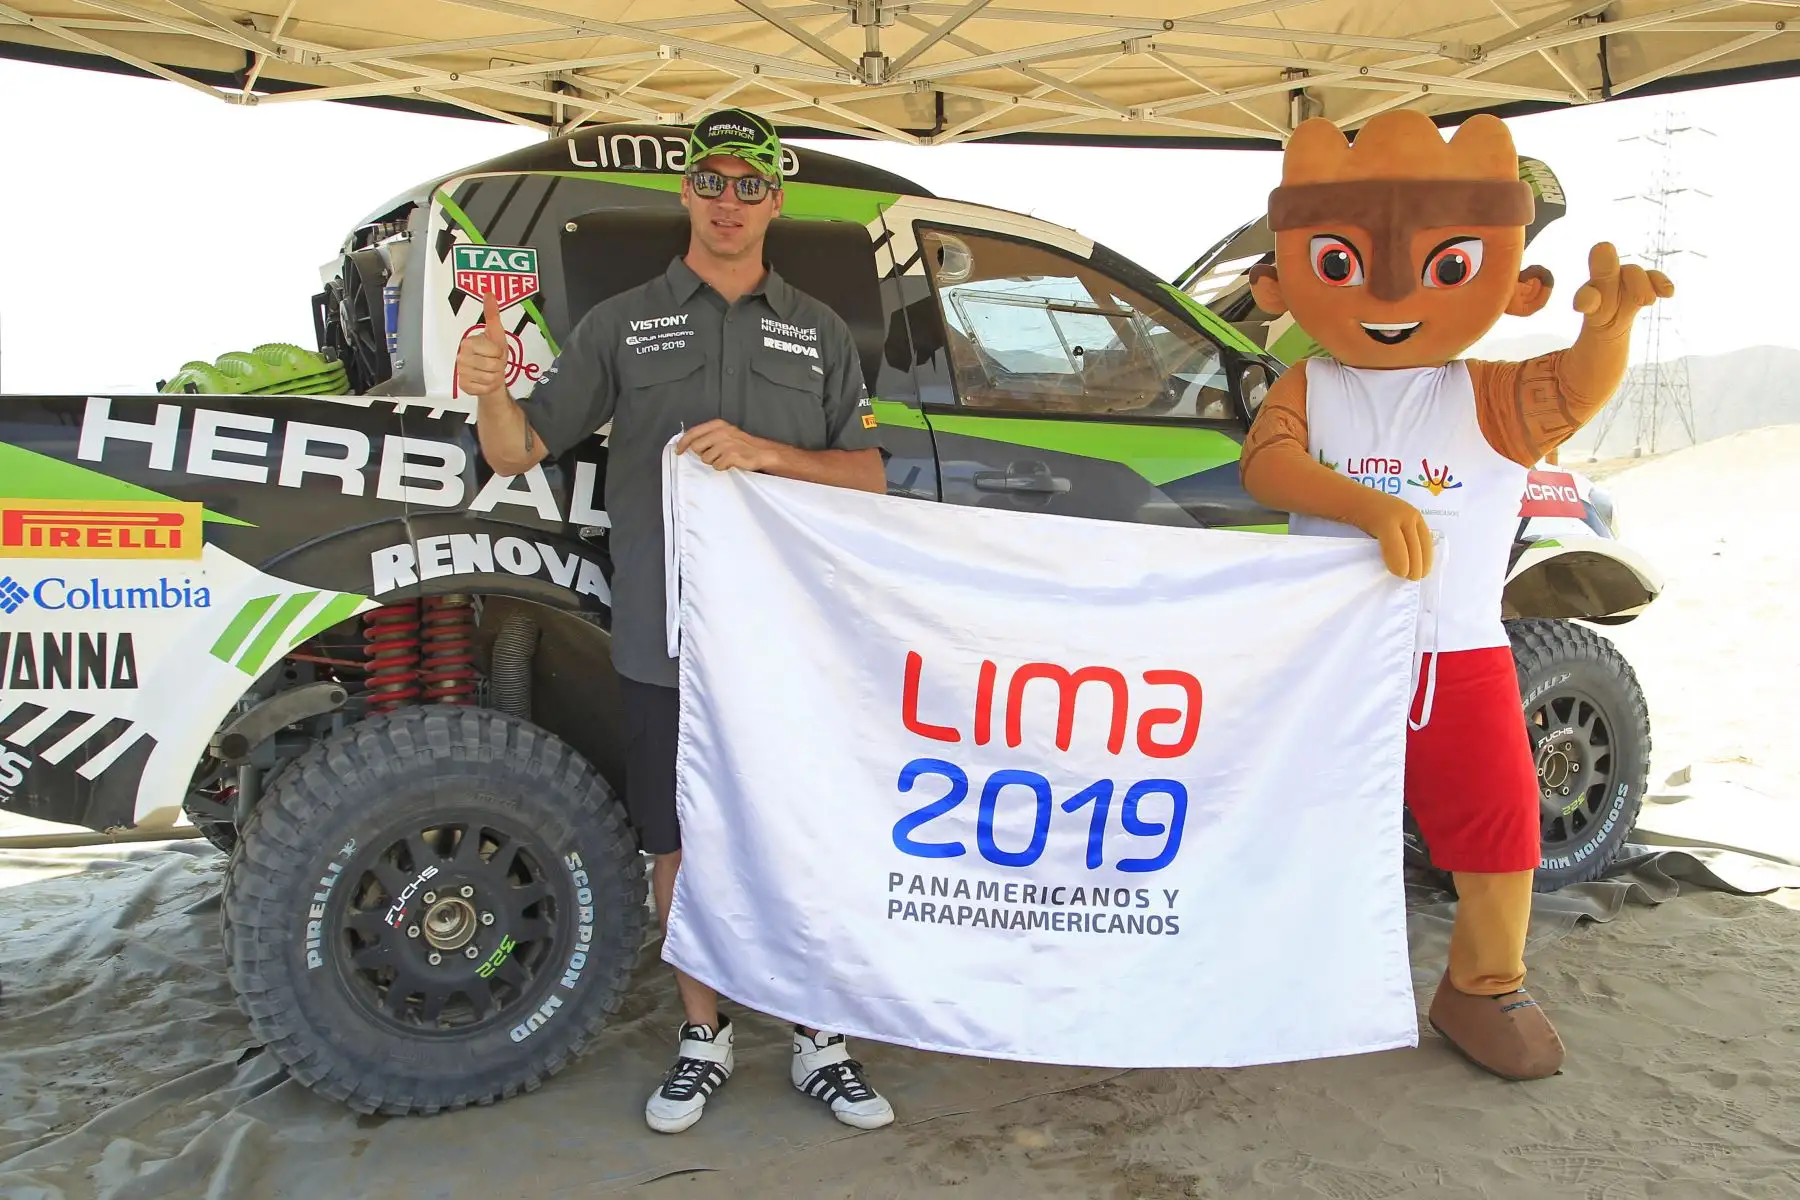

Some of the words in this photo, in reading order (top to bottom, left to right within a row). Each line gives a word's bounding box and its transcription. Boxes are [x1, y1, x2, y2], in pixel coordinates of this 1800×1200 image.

[708, 130, 754, 141] NUTRITION
[709, 124, 755, 135] HERBALIFE
[461, 249, 530, 271] TAG
[461, 274, 535, 305] HEUER
[630, 314, 688, 331] VISTONY
[761, 317, 817, 335] HERBALIFE
[761, 324, 817, 341] NUTRITION
[662, 340, 685, 350] 2019
[764, 336, 819, 359] RENOVA
[1350, 476, 1401, 494] 019
[3, 509, 184, 548] PIRELLI
[371, 533, 612, 605] RENOVA
[33, 577, 211, 610] Columbia
[1537, 727, 1574, 748] FUCHS
[892, 757, 1188, 872] 2019
[1573, 783, 1628, 863] SCORPION
[1540, 856, 1571, 870] MUD
[384, 864, 439, 926] FUCHS
[888, 871, 1150, 909] PANAMERICANOS
[1163, 888, 1180, 909] Y
[306, 862, 343, 969] PIRELLI
[561, 851, 595, 990] SCORPION
[887, 898, 1180, 936] PARAPANAMERICANOS
[475, 934, 516, 978] 322
[509, 995, 564, 1044] MUD
